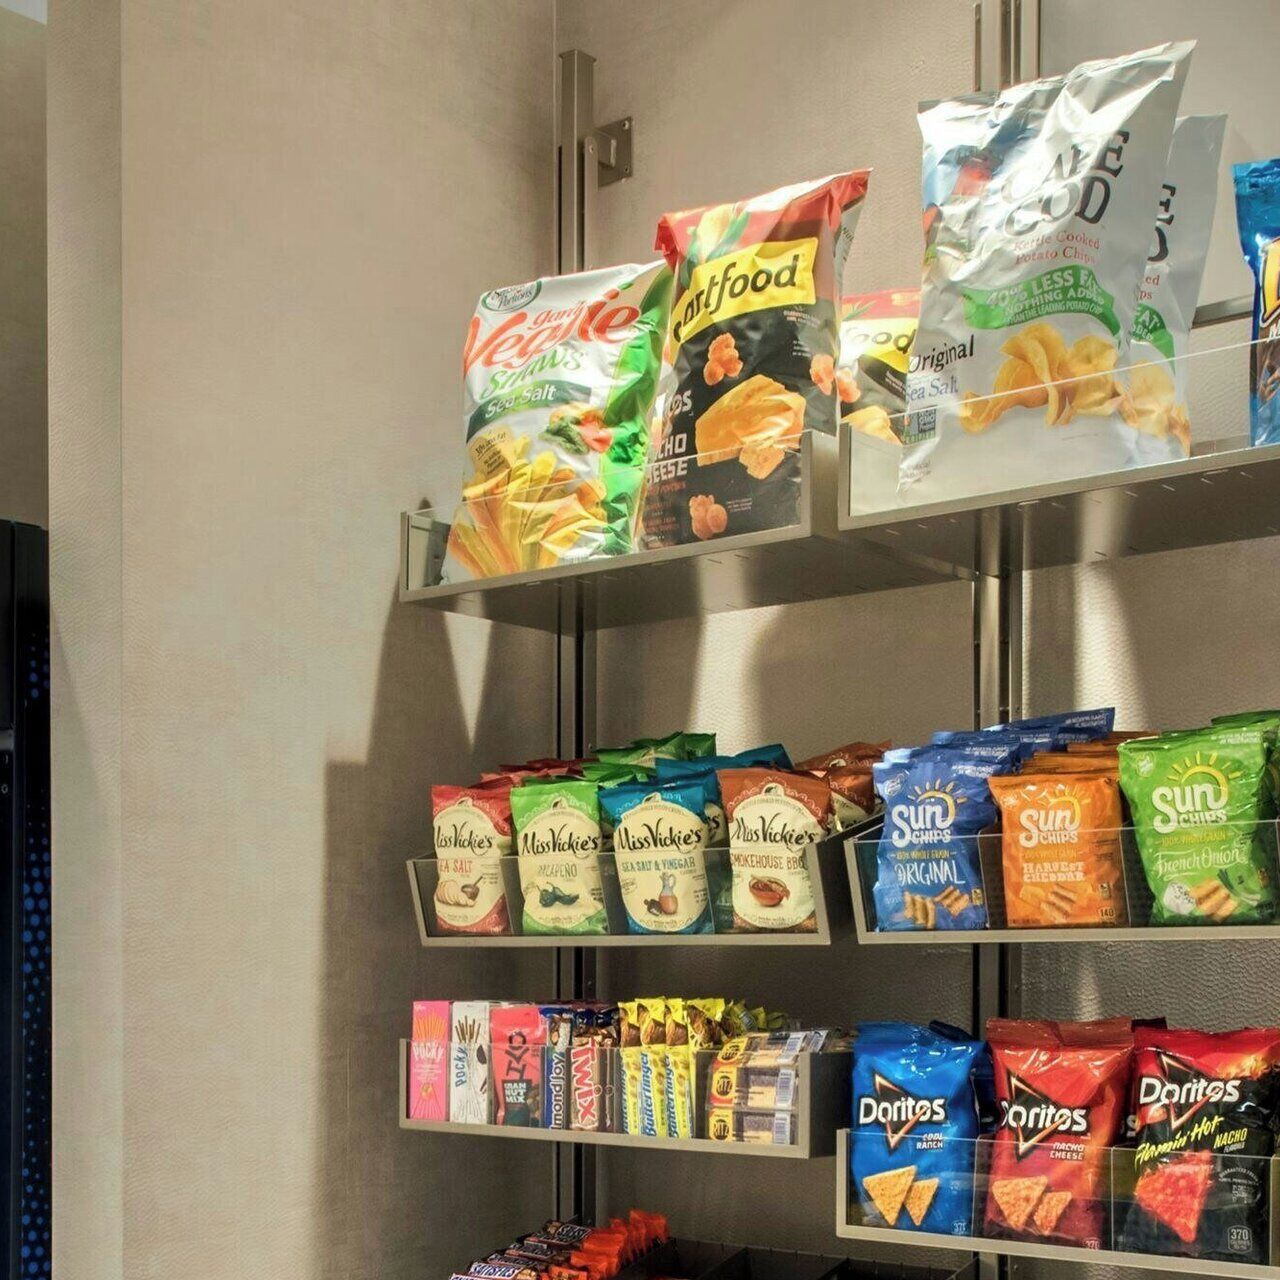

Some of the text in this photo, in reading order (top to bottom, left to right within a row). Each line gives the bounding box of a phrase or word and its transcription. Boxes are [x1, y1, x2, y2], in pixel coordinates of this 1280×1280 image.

[485, 384, 558, 418] Sea Salt
[621, 860, 635, 872] SEA
[636, 859, 652, 872] SALT
[662, 857, 696, 872] VINEGAR
[1139, 1076, 1241, 1105] Doritos
[859, 1097, 946, 1125] Doritos
[916, 1141, 944, 1150] RANCH
[1213, 1128, 1248, 1150] NACHO
[1049, 1151, 1084, 1161] CHEESE
[1230, 1228, 1249, 1240] 370
